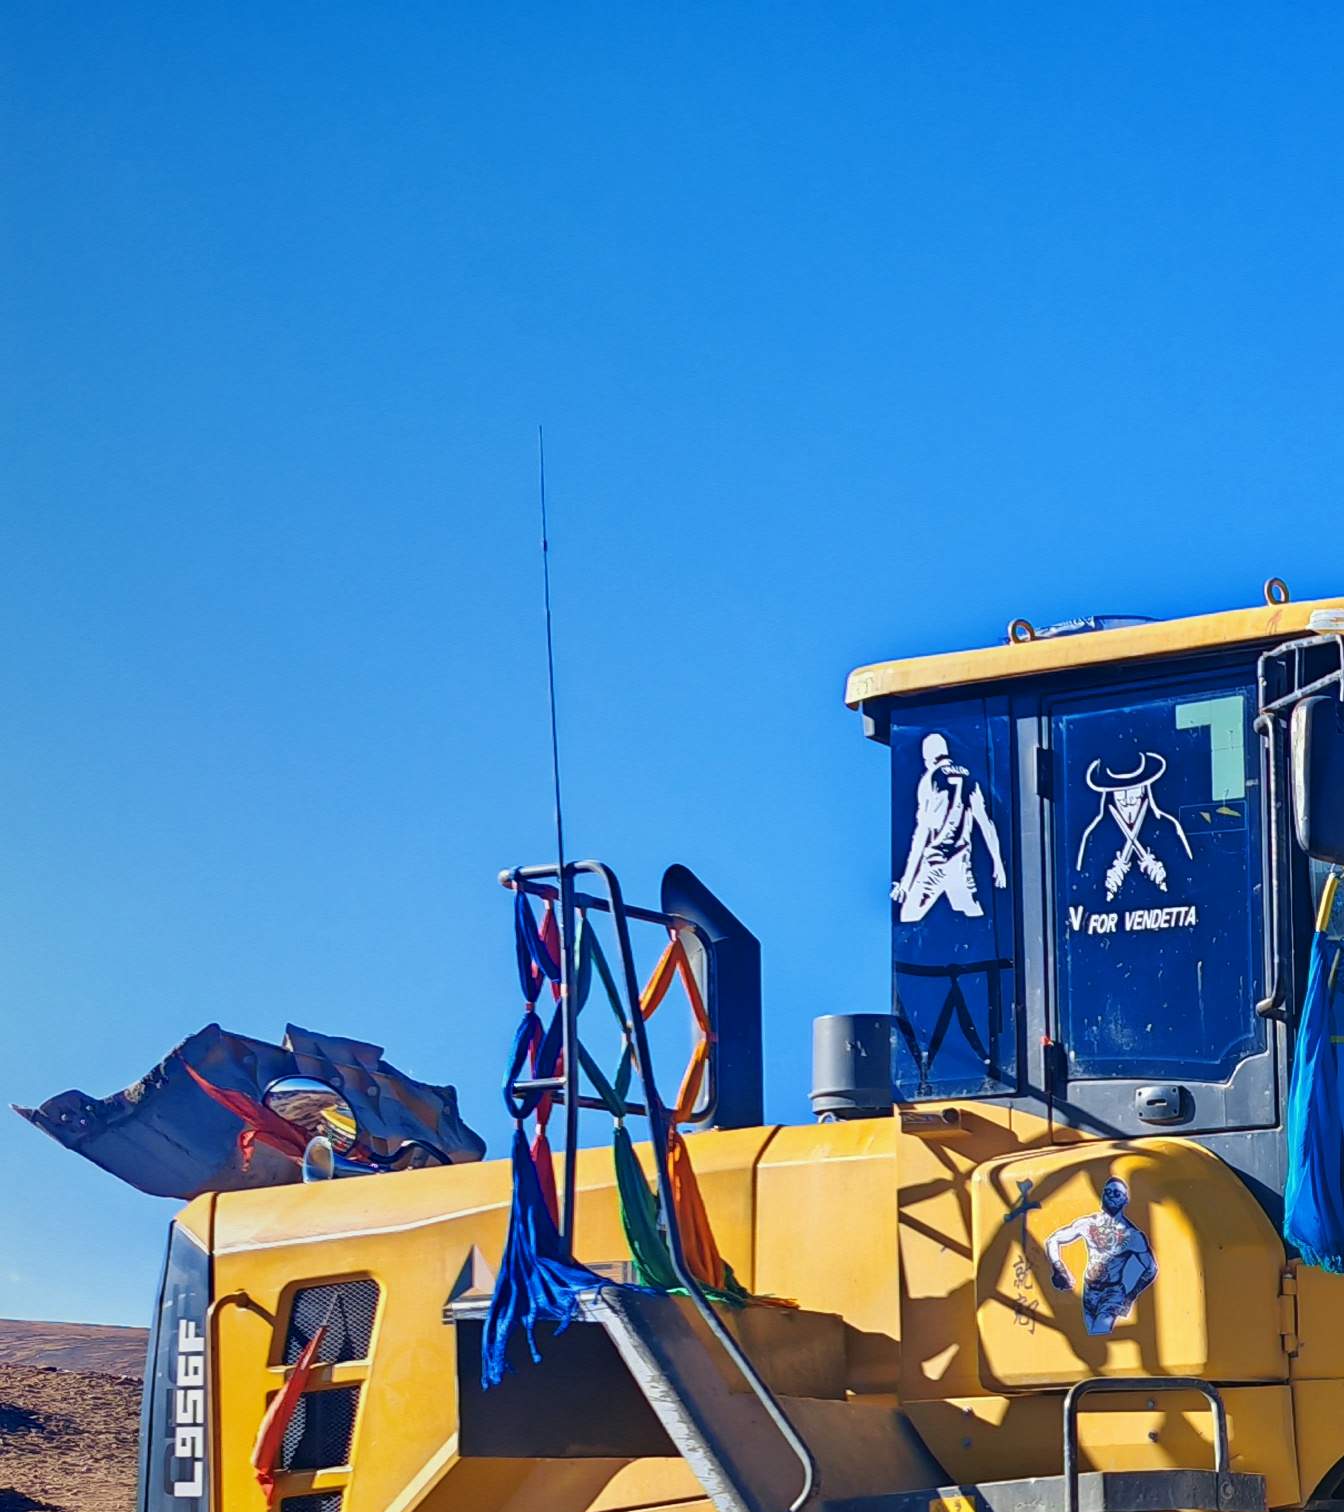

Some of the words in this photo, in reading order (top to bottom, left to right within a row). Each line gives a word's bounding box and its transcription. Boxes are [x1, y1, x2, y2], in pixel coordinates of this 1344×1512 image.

[1069, 905, 1084, 932] V
[1088, 913, 1118, 935] FOR
[1124, 905, 1197, 932] VENDETTA
[174, 1318, 206, 1498] L956F
